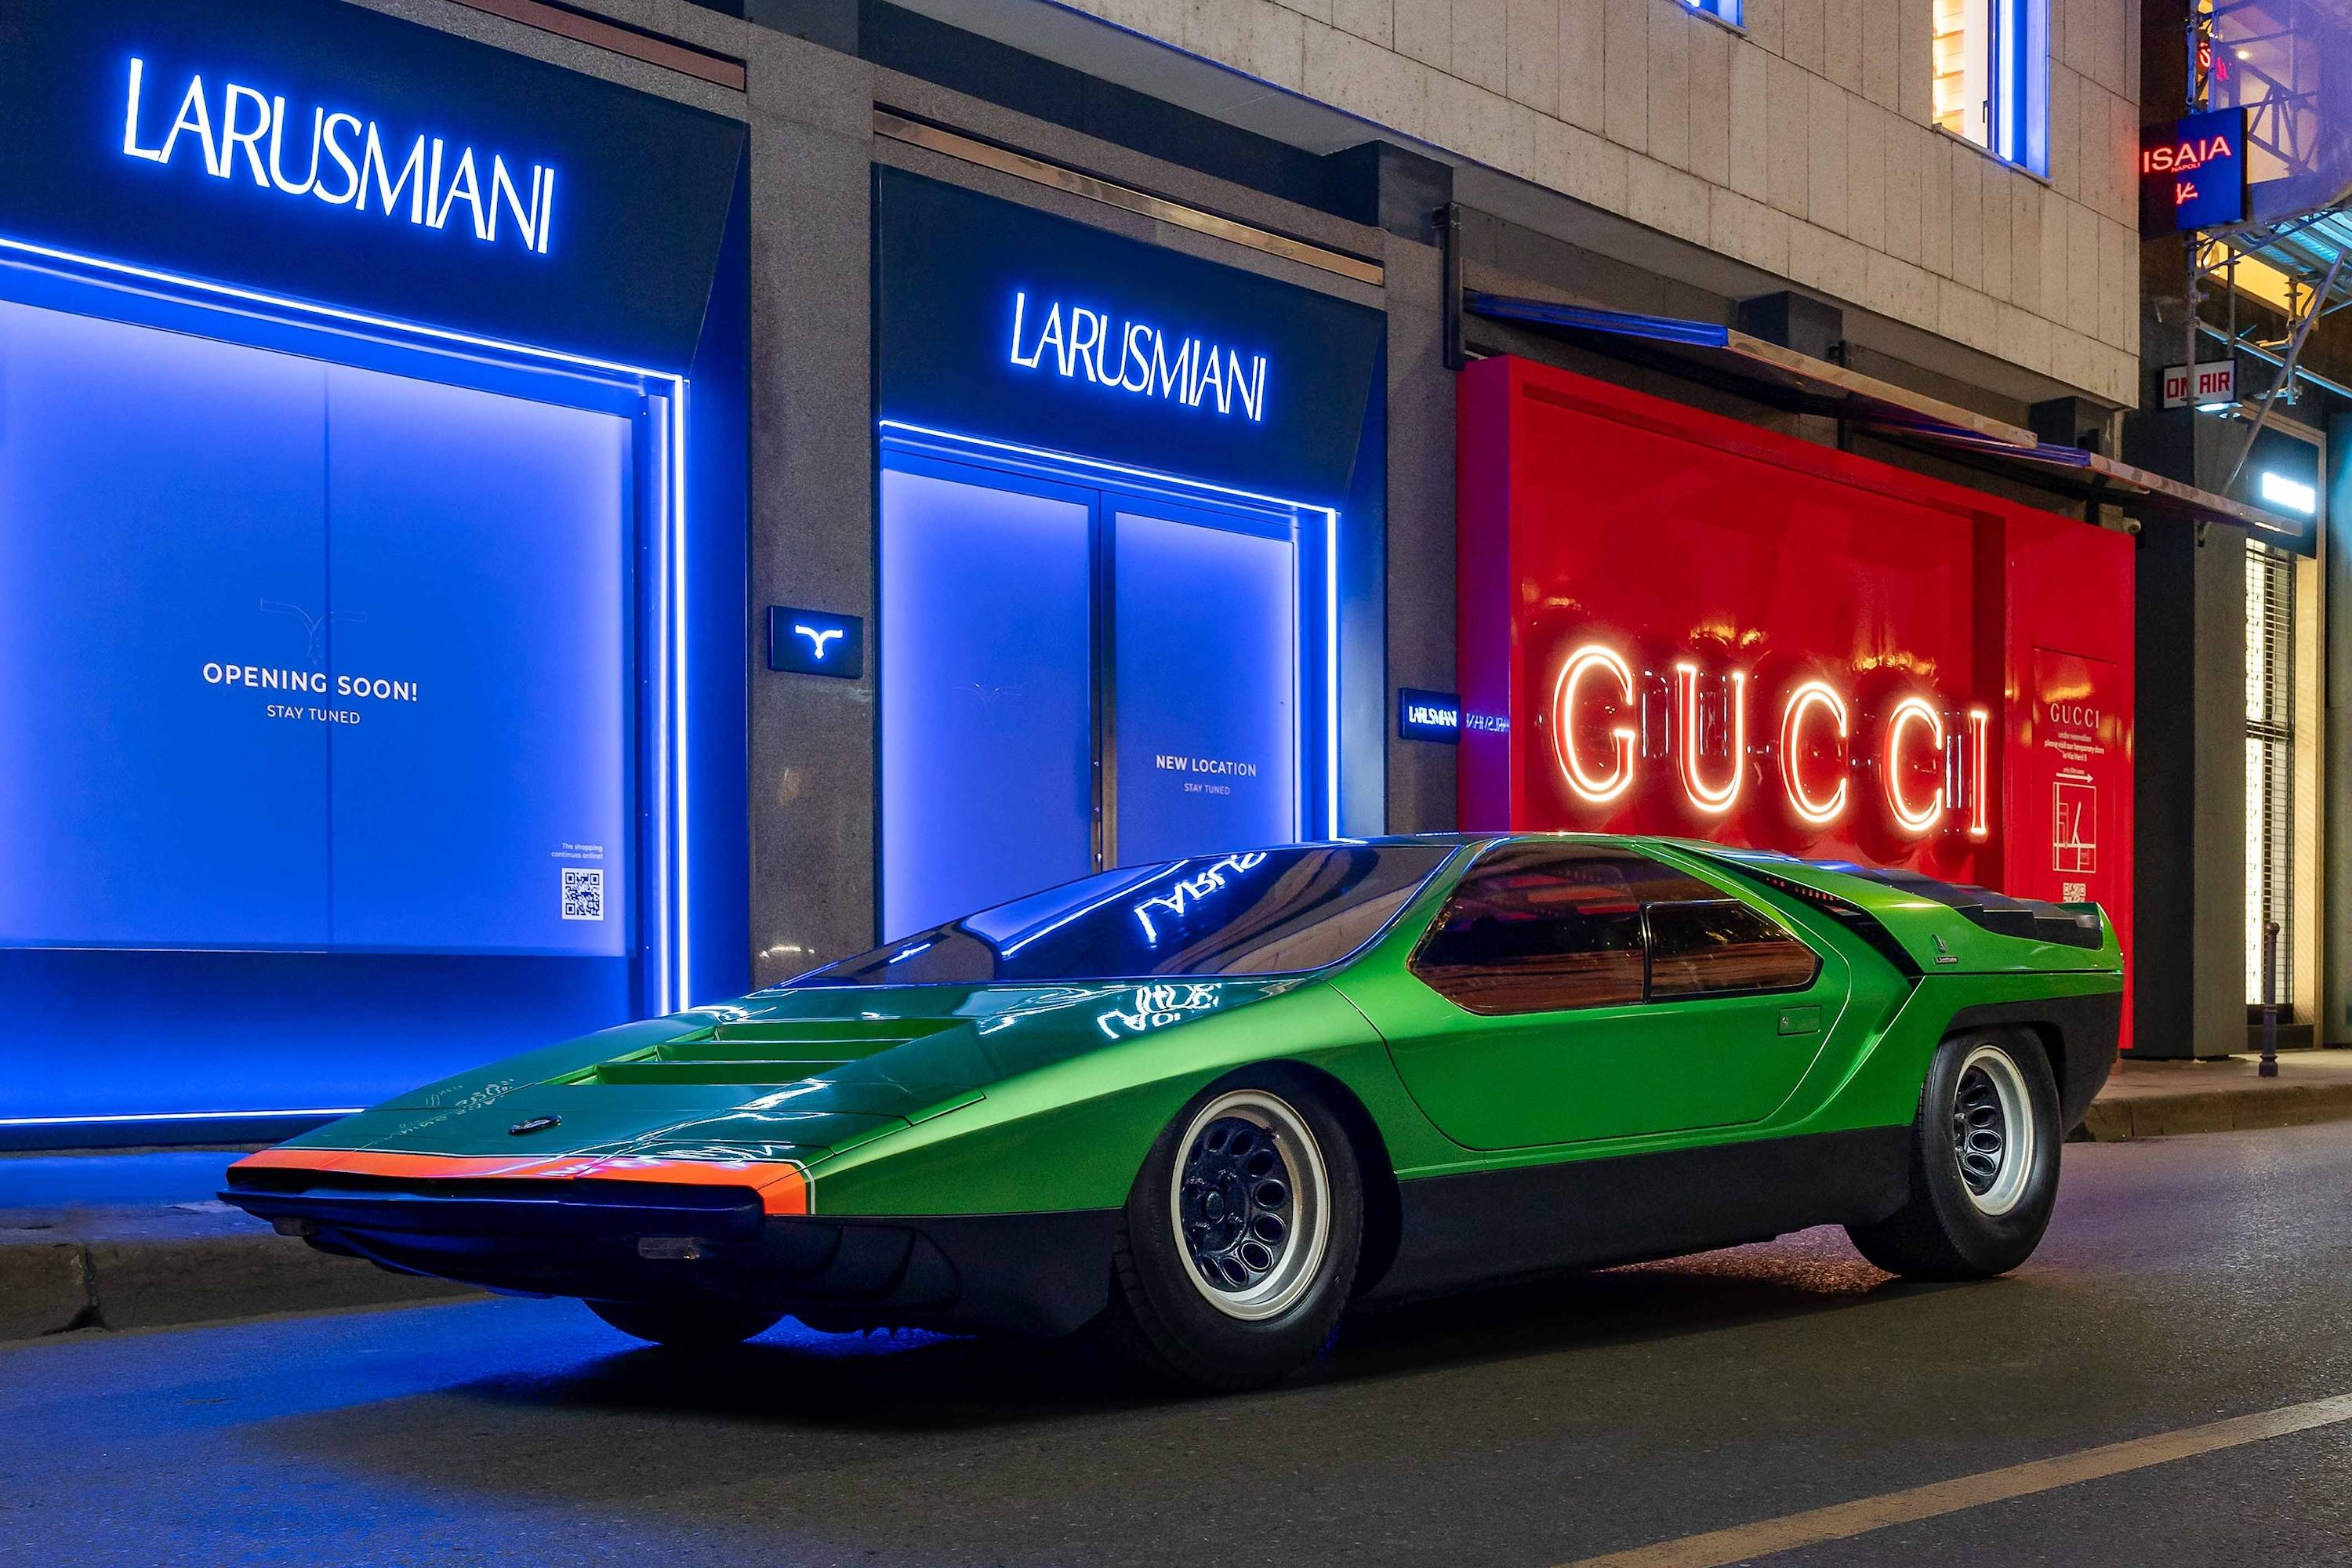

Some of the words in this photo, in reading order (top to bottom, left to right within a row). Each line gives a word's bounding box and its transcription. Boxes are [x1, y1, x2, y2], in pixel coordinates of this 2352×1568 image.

[123, 57, 554, 254] LARUSMIANI
[2143, 136, 2232, 172] ISAIA
[2171, 162, 2201, 172] NAPOLI
[1011, 292, 1266, 421] LARUSMIANI
[2199, 372, 2230, 394] AIR
[202, 662, 326, 693] OPENING
[337, 675, 418, 702] SOON!
[267, 705, 303, 720] STAY
[309, 708, 361, 724] TUNED
[2050, 702, 2099, 728] GUCCI
[1553, 645, 1989, 836] GUCCI
[1156, 754, 1187, 771] NEW
[1192, 758, 1256, 777] LOCATION
[1184, 782, 1203, 793] STAY
[1204, 784, 1231, 795] TUNED
